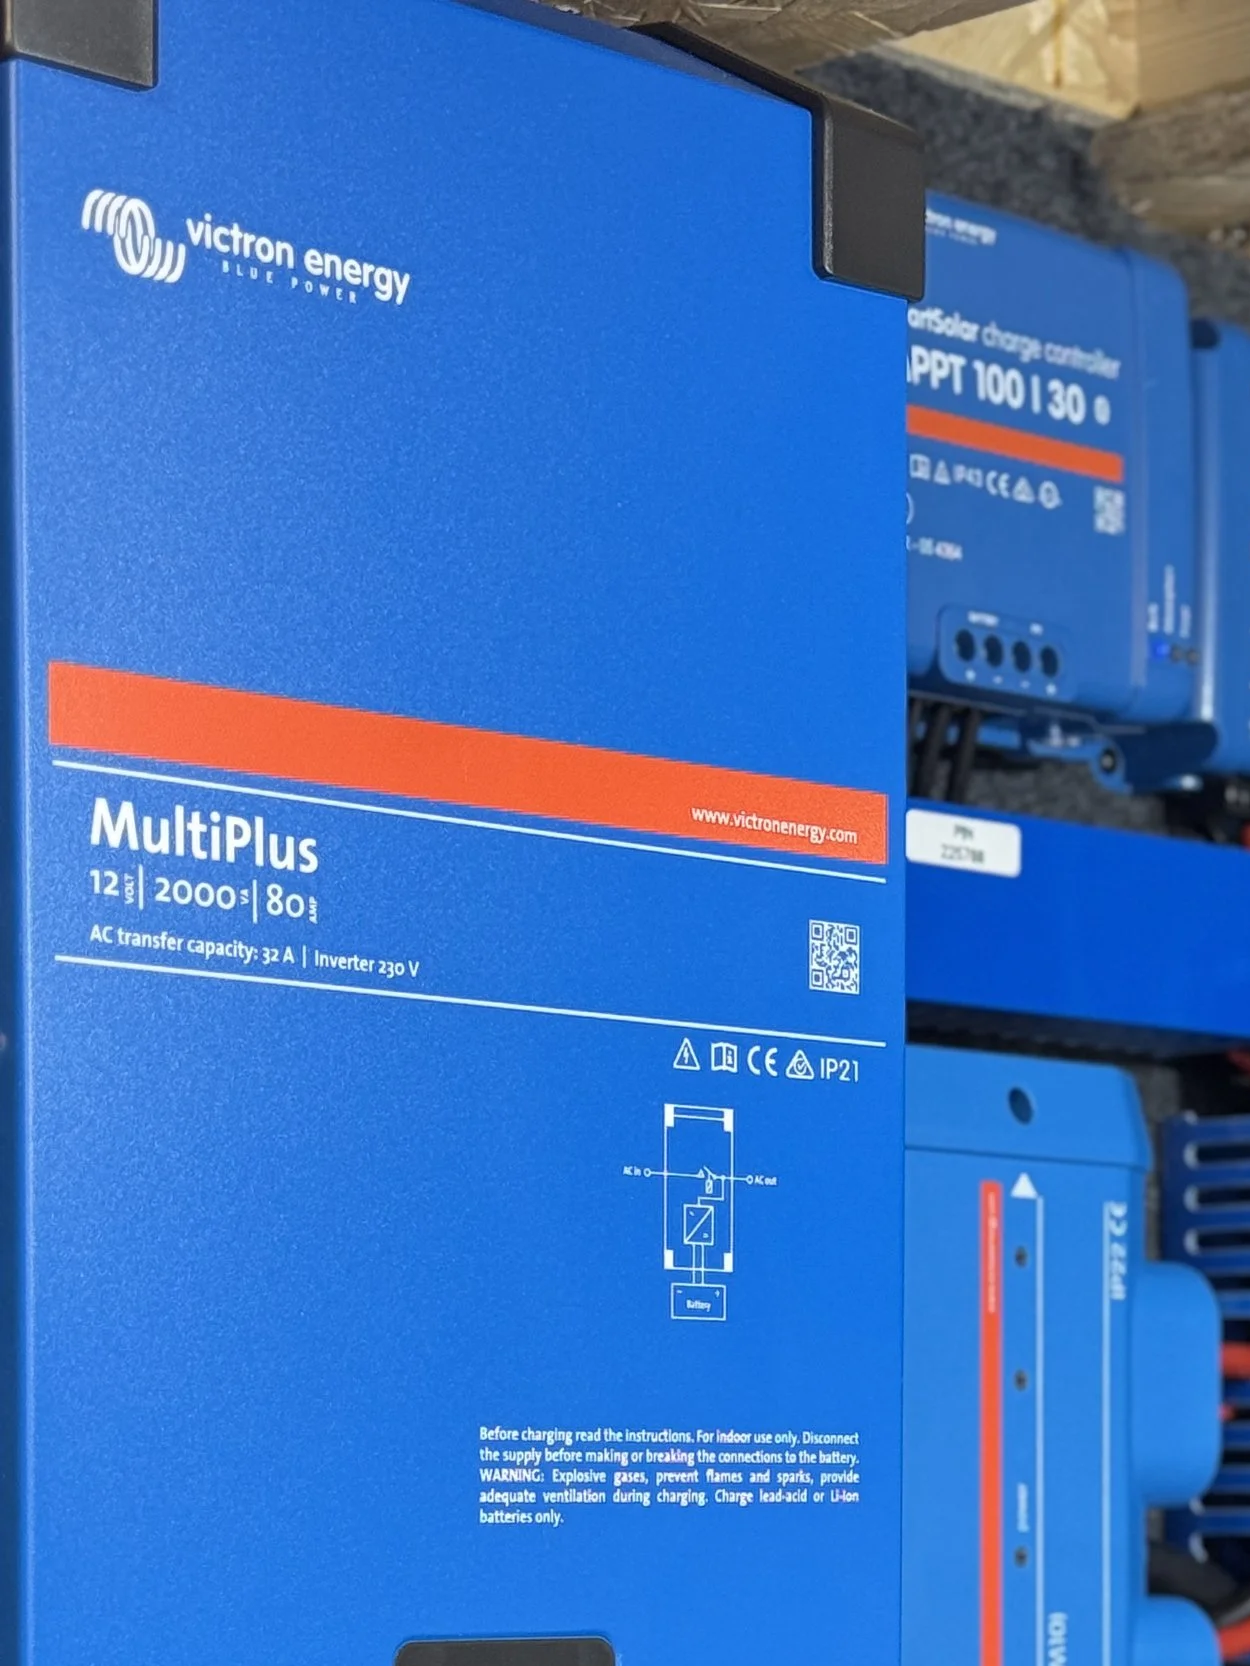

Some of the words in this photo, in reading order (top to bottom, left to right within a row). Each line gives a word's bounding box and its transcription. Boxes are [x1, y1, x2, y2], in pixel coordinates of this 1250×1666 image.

[186, 213, 294, 269] victron
[303, 248, 410, 305] energy
[221, 259, 274, 285] BLUE
[290, 276, 356, 305] POWER
[907, 307, 980, 342] artSolar
[982, 320, 1042, 363] charge
[907, 345, 967, 395] PPT
[972, 360, 1025, 410] 100
[1047, 378, 1086, 425] 30
[90, 797, 318, 873] MultiPlus
[691, 806, 858, 845] www.victronenergy.com
[90, 868, 120, 898] 12
[155, 876, 236, 910] 2000
[266, 884, 305, 919] 80
[90, 923, 114, 943] AC
[117, 926, 184, 952] transfer
[187, 937, 259, 965] capacity:
[261, 948, 279, 965] 32
[282, 945, 295, 963] A
[313, 949, 375, 975] Inverter
[378, 958, 405, 980] 230
[408, 960, 420, 978] V
[819, 1056, 860, 1083] IP21
[479, 1426, 519, 1441] Before
[521, 1427, 573, 1446] charging
[575, 1428, 601, 1442] read
[603, 1428, 623, 1442] the
[625, 1429, 694, 1443] instructions.
[696, 1429, 715, 1443] For
[716, 1429, 751, 1444] indoor
[753, 1432, 772, 1444] use
[774, 1431, 800, 1447] only.
[802, 1431, 860, 1445] Disconnect
[479, 1447, 500, 1461] the
[502, 1447, 542, 1466] supply
[544, 1447, 583, 1462] before
[585, 1449, 628, 1466] making
[630, 1451, 644, 1463] or
[645, 1448, 695, 1467] breaking
[697, 1449, 716, 1463] the
[718, 1450, 782, 1463] connections
[784, 1450, 797, 1463] to
[799, 1450, 817, 1464] the
[819, 1450, 860, 1467] battery.
[479, 1468, 545, 1482] WARNING:
[552, 1468, 607, 1486] Explosive
[613, 1471, 649, 1486] gases,
[656, 1470, 699, 1486] prevent
[706, 1468, 743, 1483] flames
[749, 1469, 771, 1483] and
[776, 1470, 814, 1487] sparks,
[820, 1470, 860, 1486] provide
[479, 1488, 537, 1506] adequate
[543, 1488, 606, 1502] ventilation
[613, 1488, 651, 1506] during
[656, 1488, 709, 1507] charging.
[714, 1489, 753, 1507] Charge
[759, 1488, 808, 1503] lead-acid
[812, 1491, 825, 1503] or
[479, 1508, 533, 1523] batteries
[535, 1508, 564, 1527] only.
